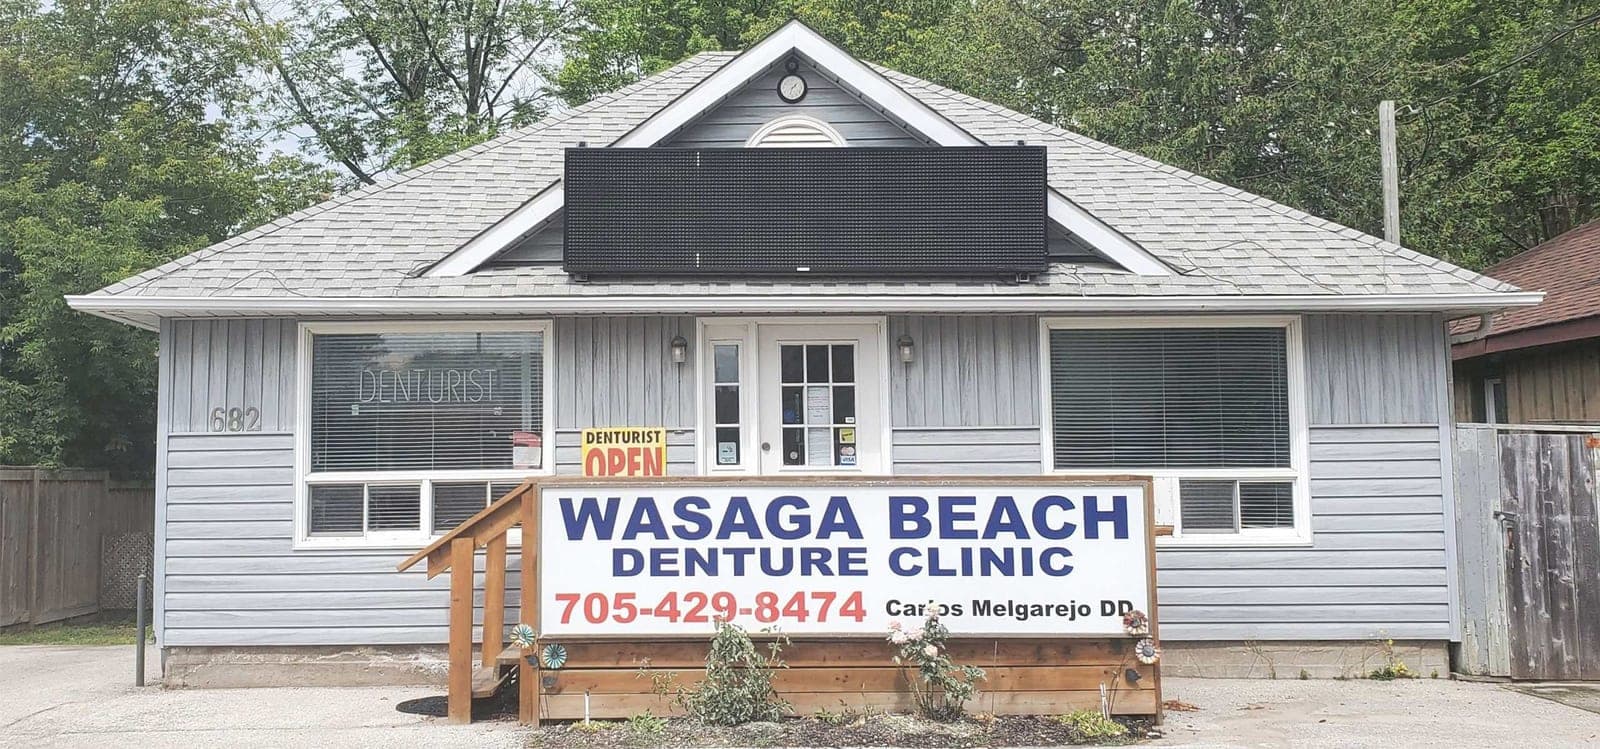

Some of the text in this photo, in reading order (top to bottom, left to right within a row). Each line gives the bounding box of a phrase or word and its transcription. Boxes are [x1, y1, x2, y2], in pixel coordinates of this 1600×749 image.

[359, 368, 497, 404] DENTURIST
[210, 407, 261, 432] 682
[586, 430, 661, 444] DENTURIST
[586, 447, 663, 476] OPEN
[559, 496, 1130, 541] WASAGA BEACH
[612, 547, 1074, 577] DENTURE CLINIC
[555, 591, 867, 624] 705-429-8474
[885, 599, 963, 617] Caros
[972, 599, 1092, 621] Melgarejo
